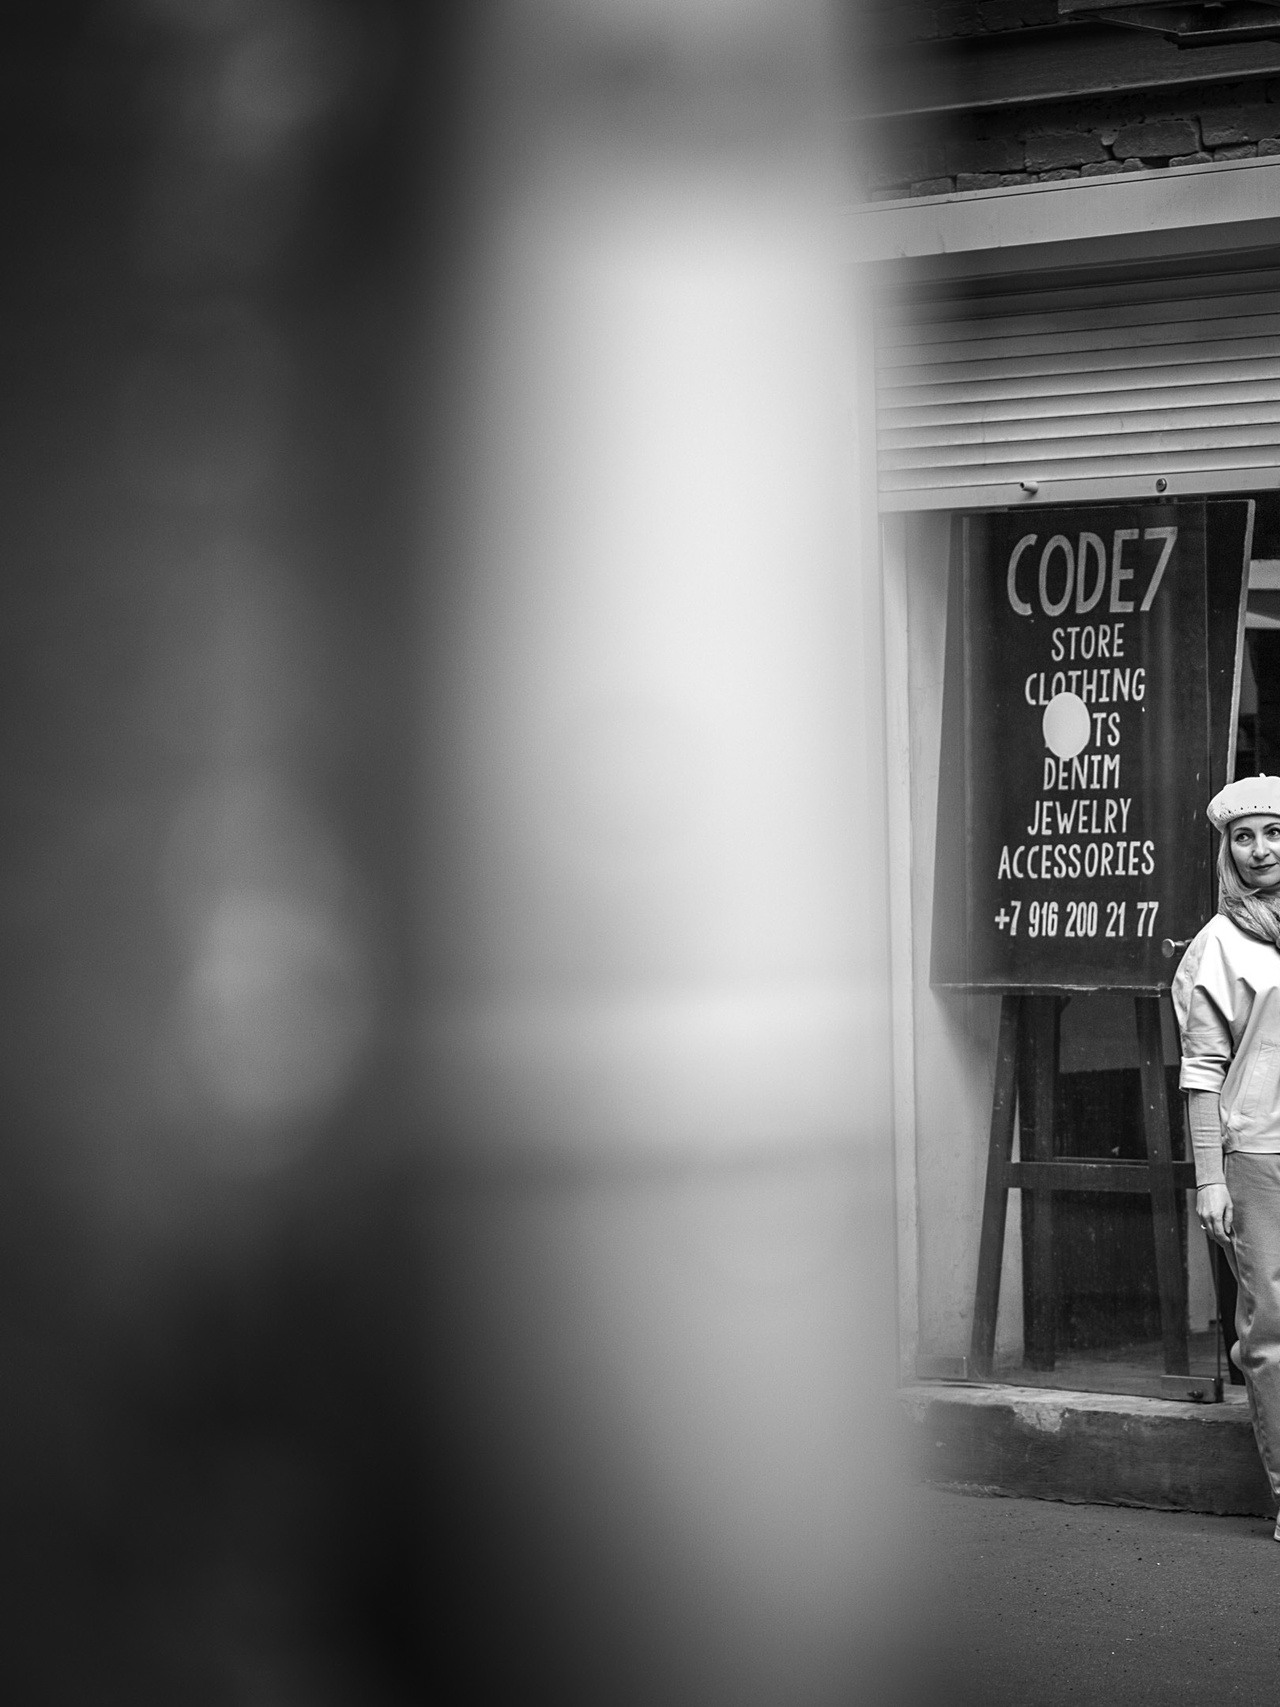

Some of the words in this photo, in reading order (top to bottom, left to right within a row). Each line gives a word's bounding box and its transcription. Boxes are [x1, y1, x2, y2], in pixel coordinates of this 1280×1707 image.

[1007, 527, 1177, 616] CODE7
[1052, 623, 1124, 661] STORE
[1025, 668, 1145, 705] CLOTHING
[1043, 754, 1120, 790] DENIM
[1028, 798, 1131, 835] JEWELRY
[998, 841, 1154, 879] ACCESSORIES
[995, 901, 1021, 935] +7
[1029, 902, 1058, 937] 916
[1065, 902, 1097, 937] 200
[1106, 902, 1125, 937] 21
[1137, 902, 1158, 937] 77
